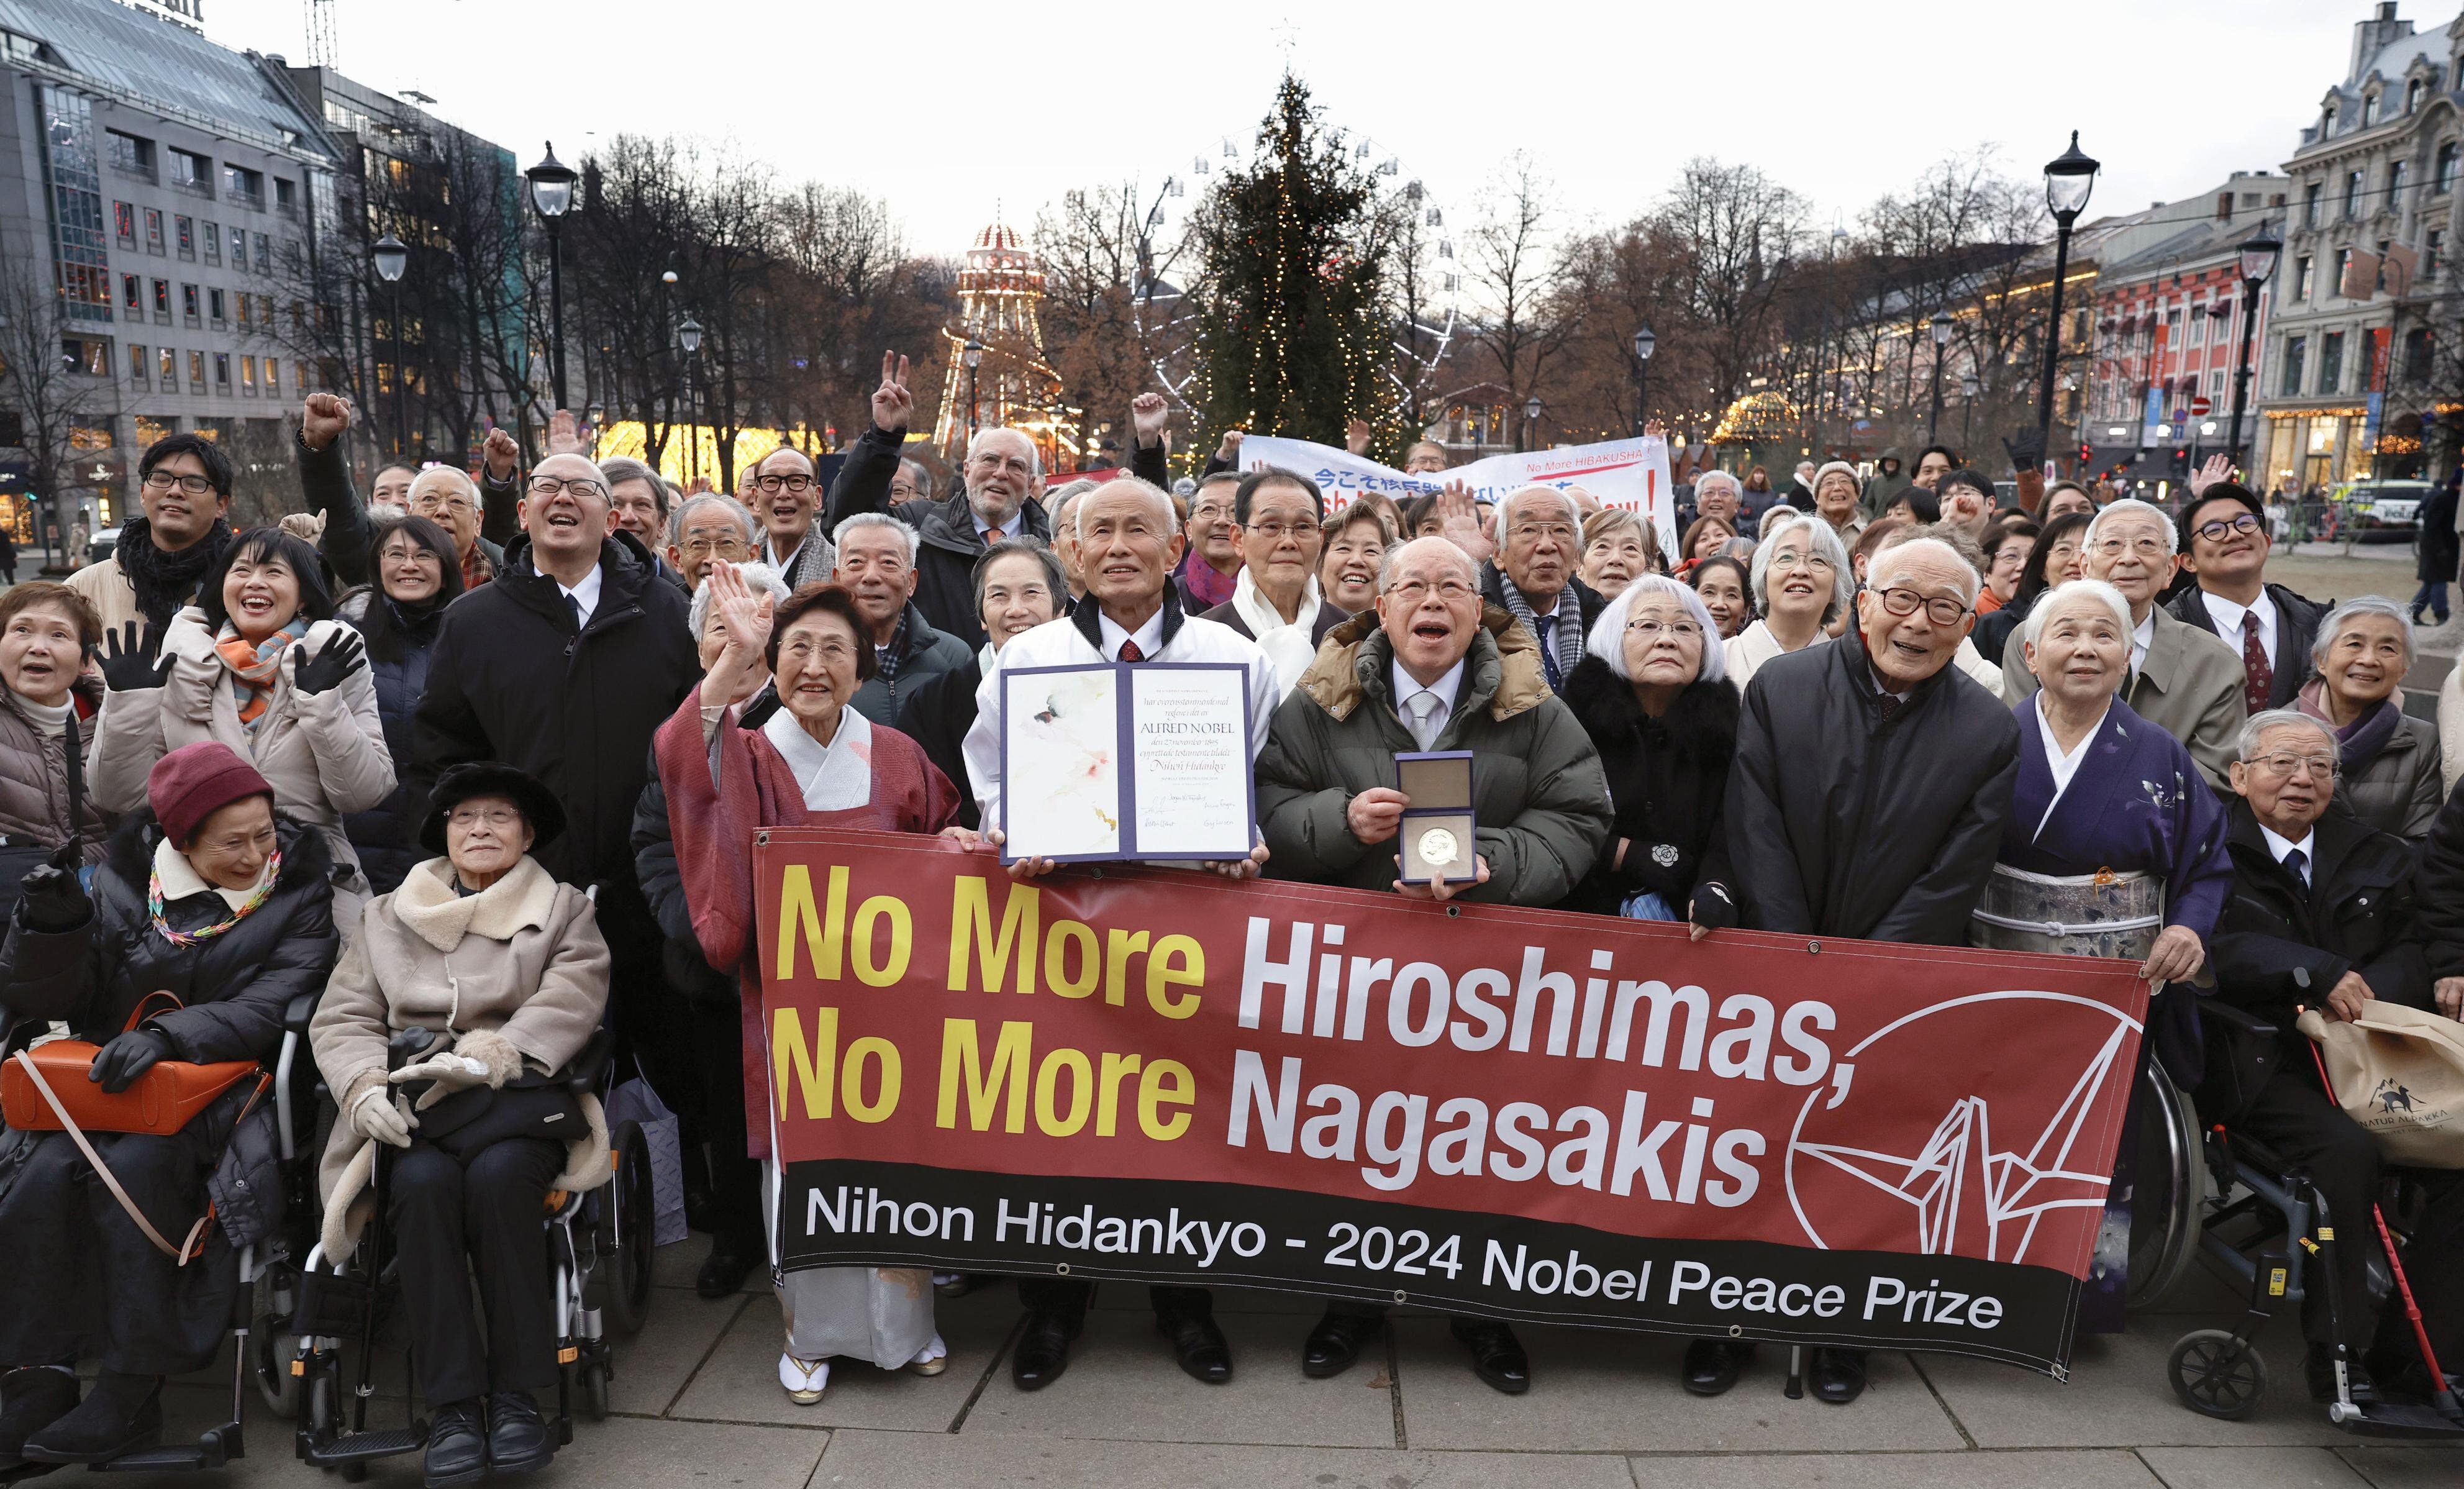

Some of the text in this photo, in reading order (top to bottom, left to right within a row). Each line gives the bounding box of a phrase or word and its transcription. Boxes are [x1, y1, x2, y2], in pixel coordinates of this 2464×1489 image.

[1527, 463, 1541, 472] No
[1545, 461, 1572, 471] More
[1575, 450, 1643, 467] HIBAKUSHA
[1140, 722, 1235, 734] ALFRED NOBEL
[777, 865, 1855, 1109] No More Hiroshimas,
[773, 1008, 1765, 1207] No More Nagasakis
[2360, 1118, 2394, 1127] NATUR
[807, 1186, 2003, 1328] Nihon Hidankyo - 2024 Nobel Peace Prize
